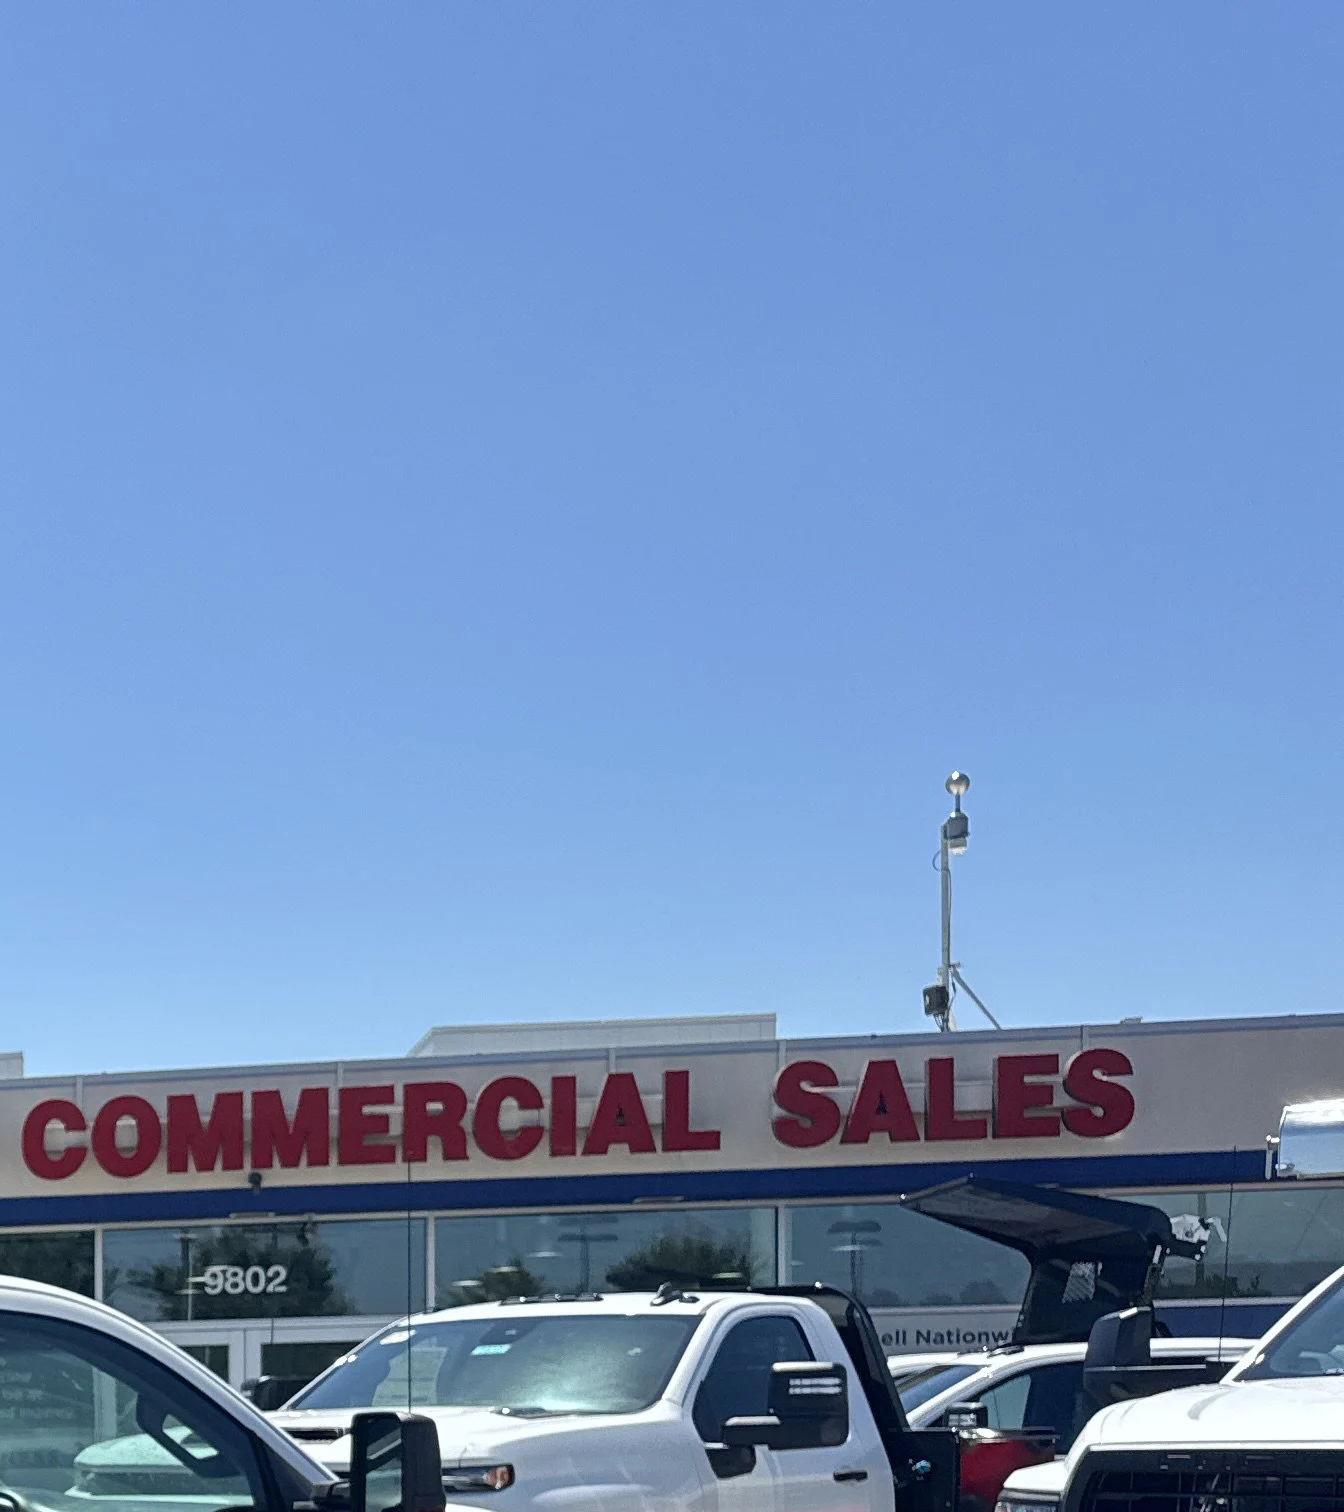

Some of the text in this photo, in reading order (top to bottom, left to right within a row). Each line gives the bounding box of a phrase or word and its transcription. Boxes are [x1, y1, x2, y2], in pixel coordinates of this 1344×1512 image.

[21, 1069, 721, 1180] COMMERCIAL
[772, 1048, 1136, 1148] SALES
[204, 1265, 288, 1295] 9802
